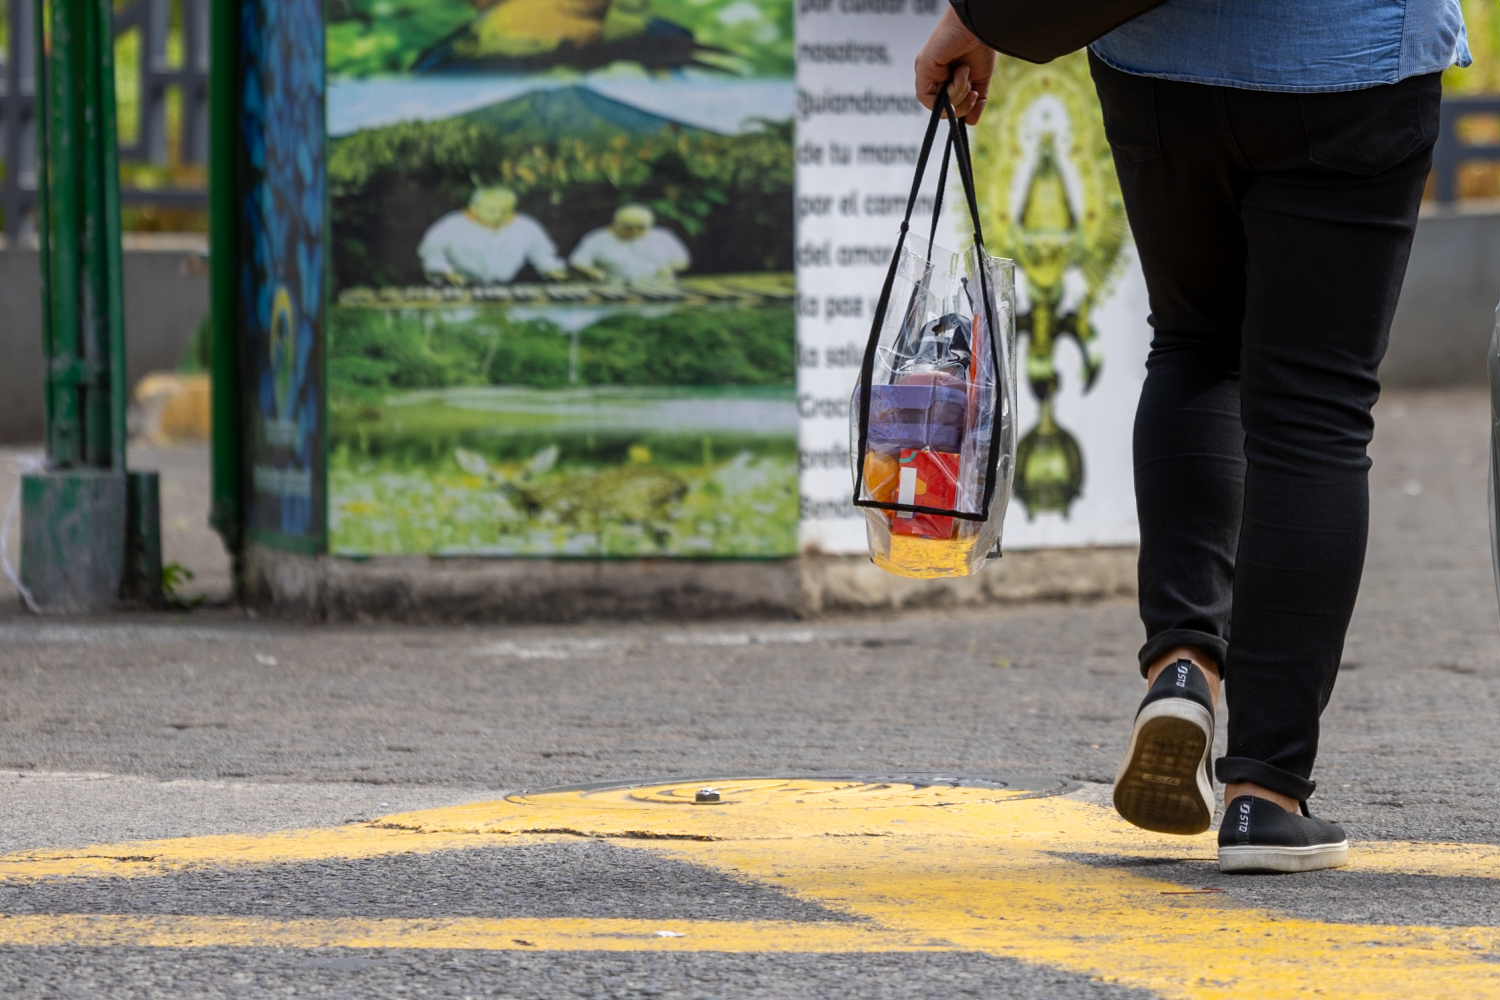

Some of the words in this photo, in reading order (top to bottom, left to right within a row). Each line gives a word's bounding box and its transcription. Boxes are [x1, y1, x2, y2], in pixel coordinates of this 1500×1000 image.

[796, 141, 824, 164] de
[829, 141, 852, 164] tu
[799, 195, 833, 220] por
[839, 190, 859, 216] el
[796, 241, 830, 266] del
[825, 296, 864, 324] paz
